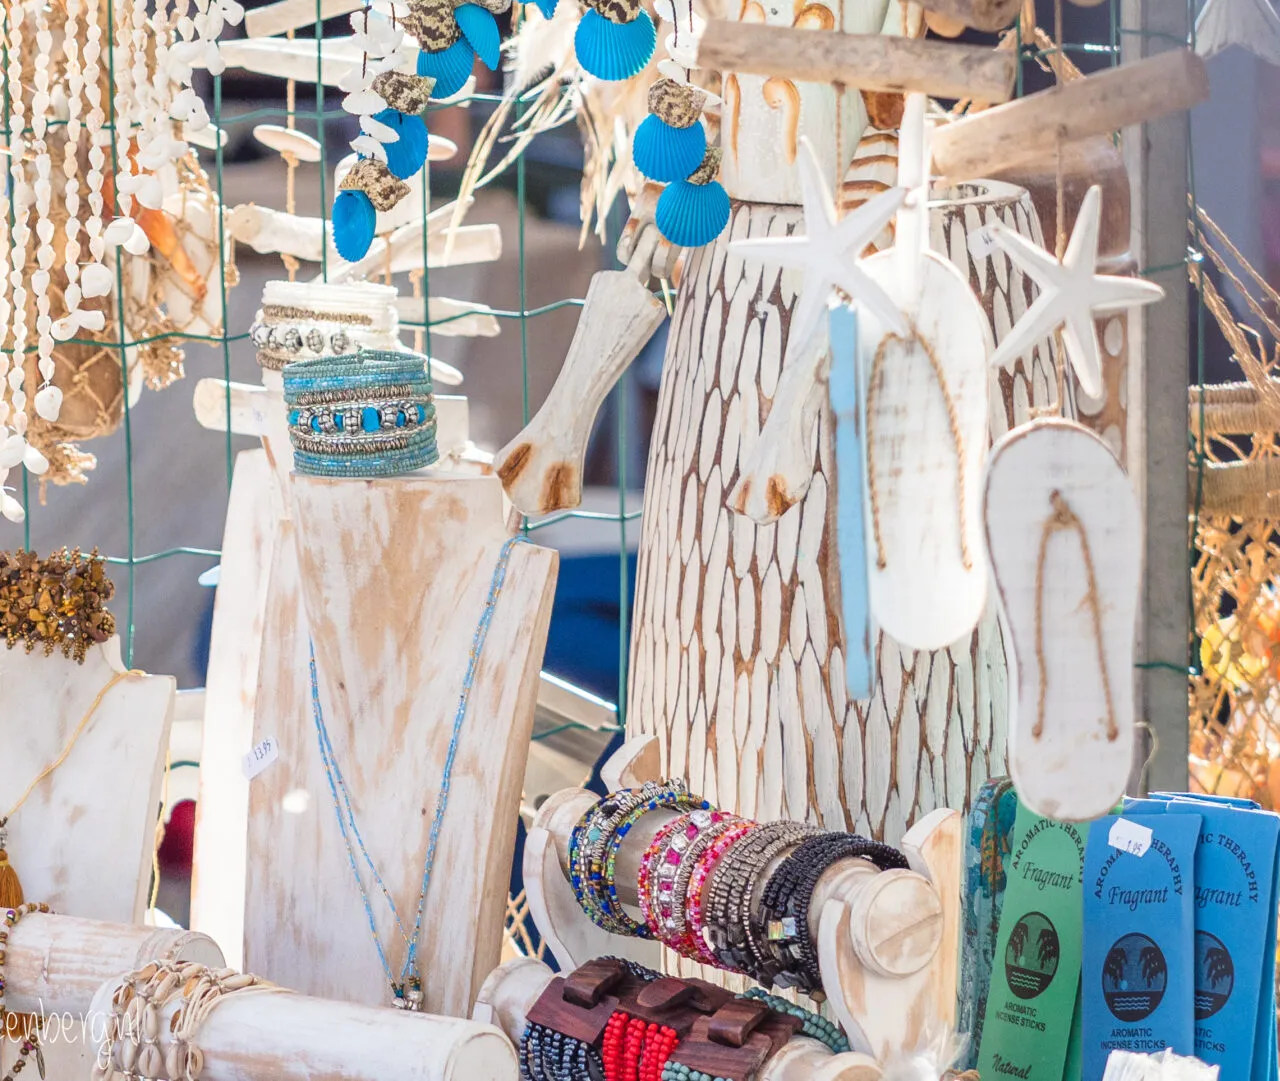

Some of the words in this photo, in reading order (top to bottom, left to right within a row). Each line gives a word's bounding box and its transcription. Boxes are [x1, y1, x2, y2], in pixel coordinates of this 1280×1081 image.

[1023, 861, 1074, 891] Fragrant
[1095, 848, 1123, 900] AROMA
[1150, 838, 1183, 896] HERAPHY
[1218, 834, 1259, 904] THERAPHY
[1108, 886, 1168, 912] Fragrant
[1195, 886, 1242, 909] agrant
[1004, 1002, 1037, 1018] AROMATIC
[1020, 1017, 1047, 1032] STICKS
[1111, 1028, 1152, 1038] AROMATIC
[1101, 1040, 1132, 1050] INCENSE
[1134, 1039, 1166, 1049] STICKS
[992, 1053, 1032, 1080] Natural
